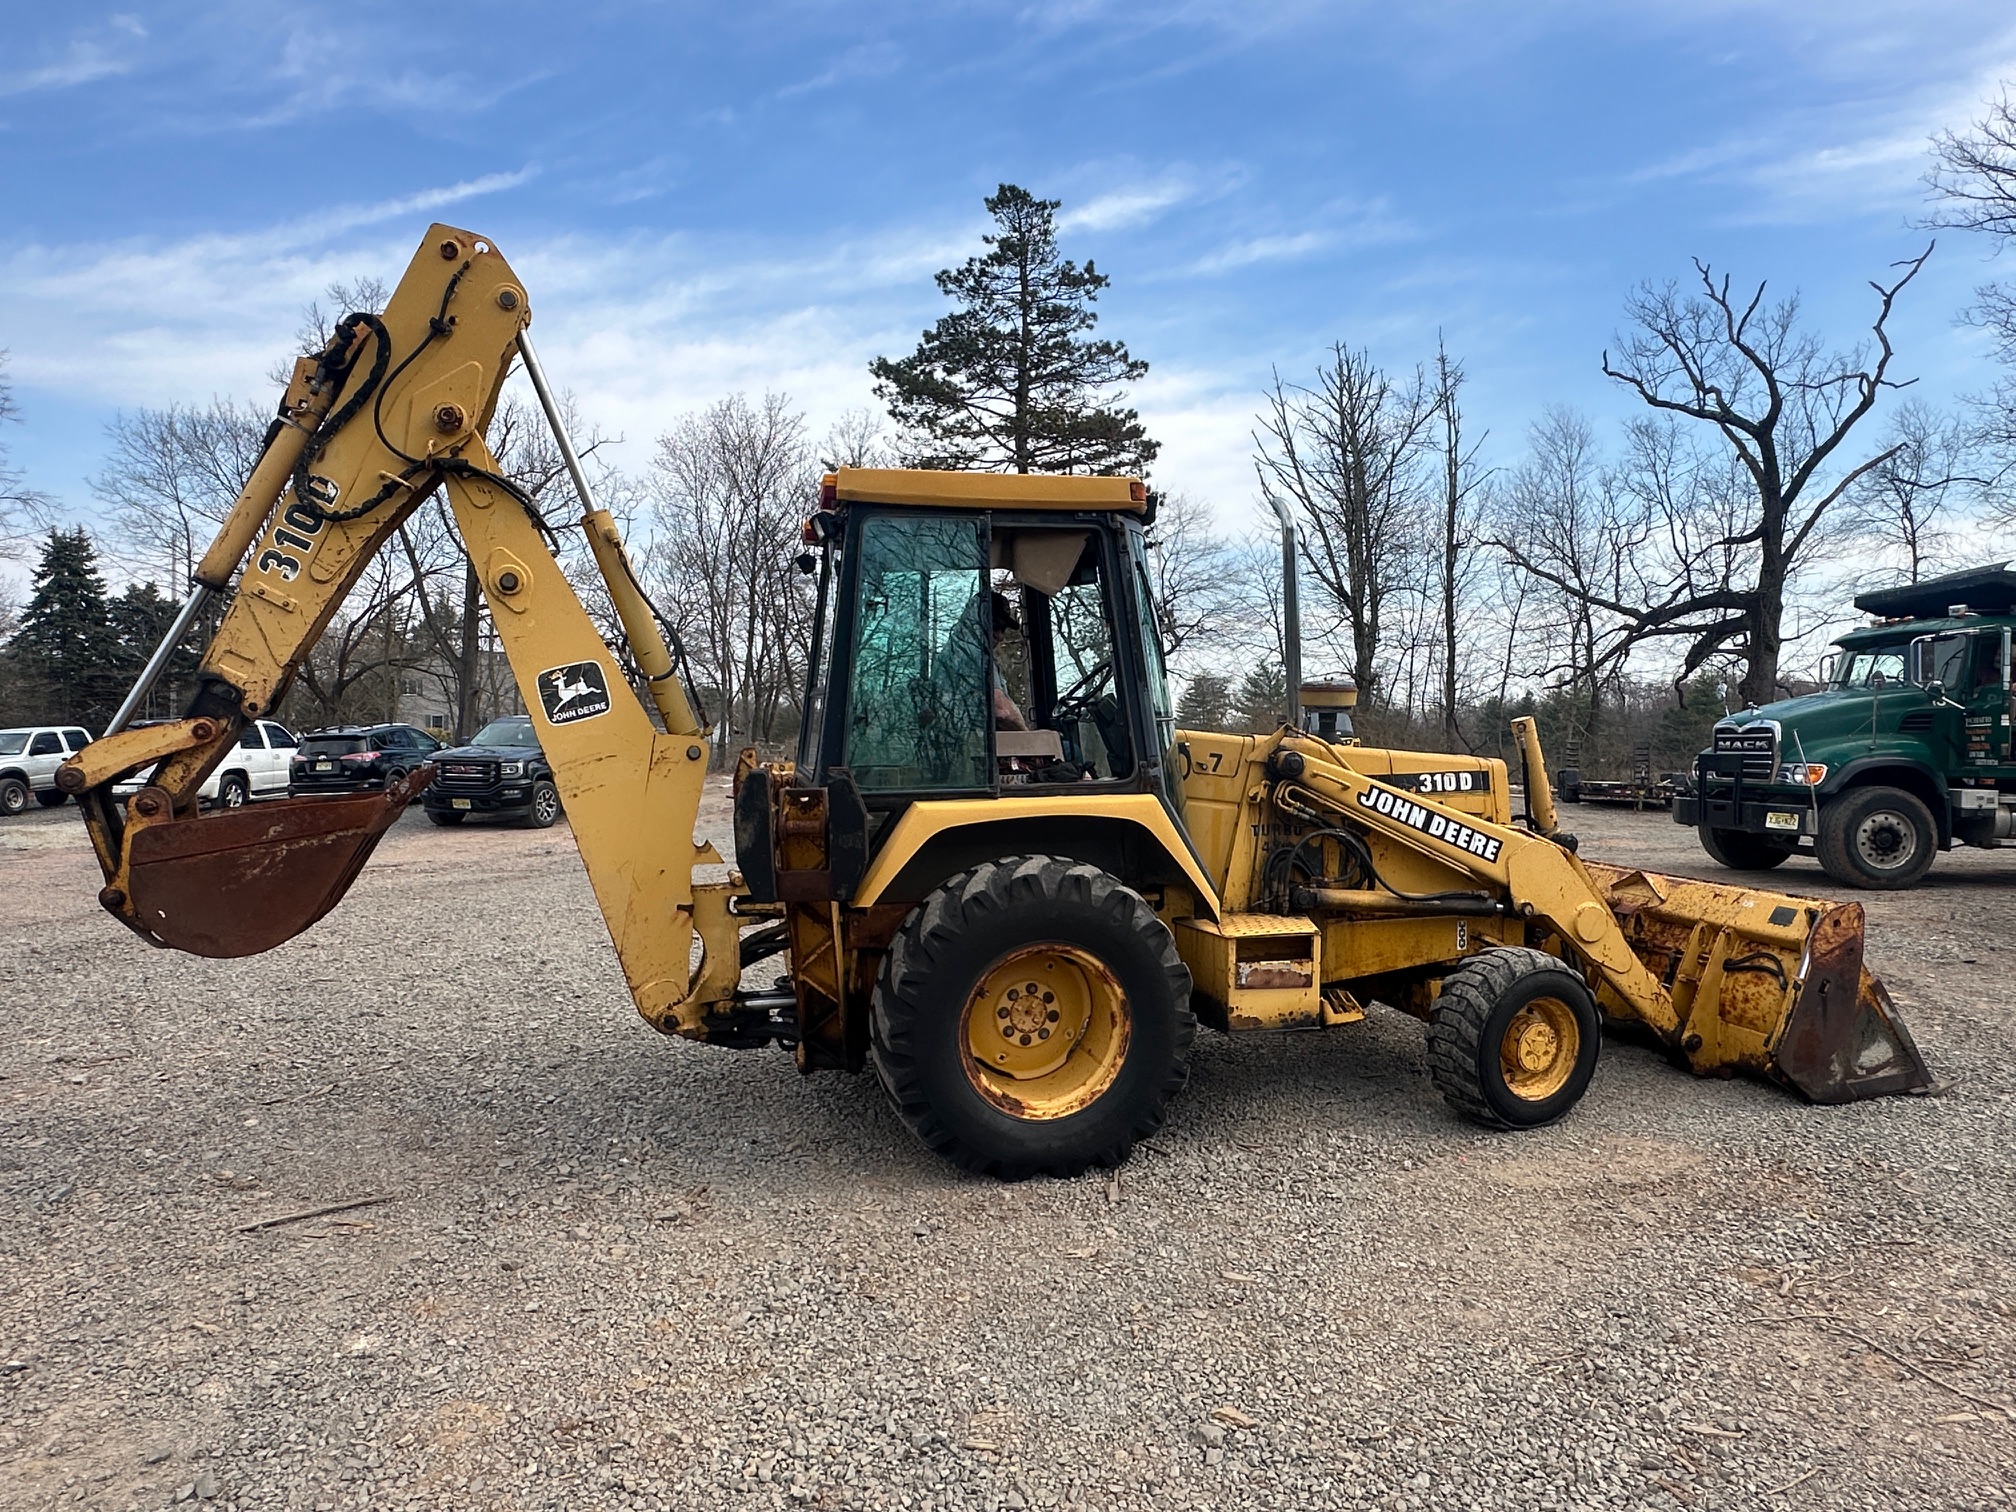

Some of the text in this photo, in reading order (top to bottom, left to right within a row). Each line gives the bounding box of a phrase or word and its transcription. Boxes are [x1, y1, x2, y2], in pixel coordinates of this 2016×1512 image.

[551, 702, 607, 722] JOHN DEERE
[1717, 740, 1769, 750] MACK
[1209, 752, 1223, 772] 7
[1360, 787, 1500, 861] JOHN DEERE
